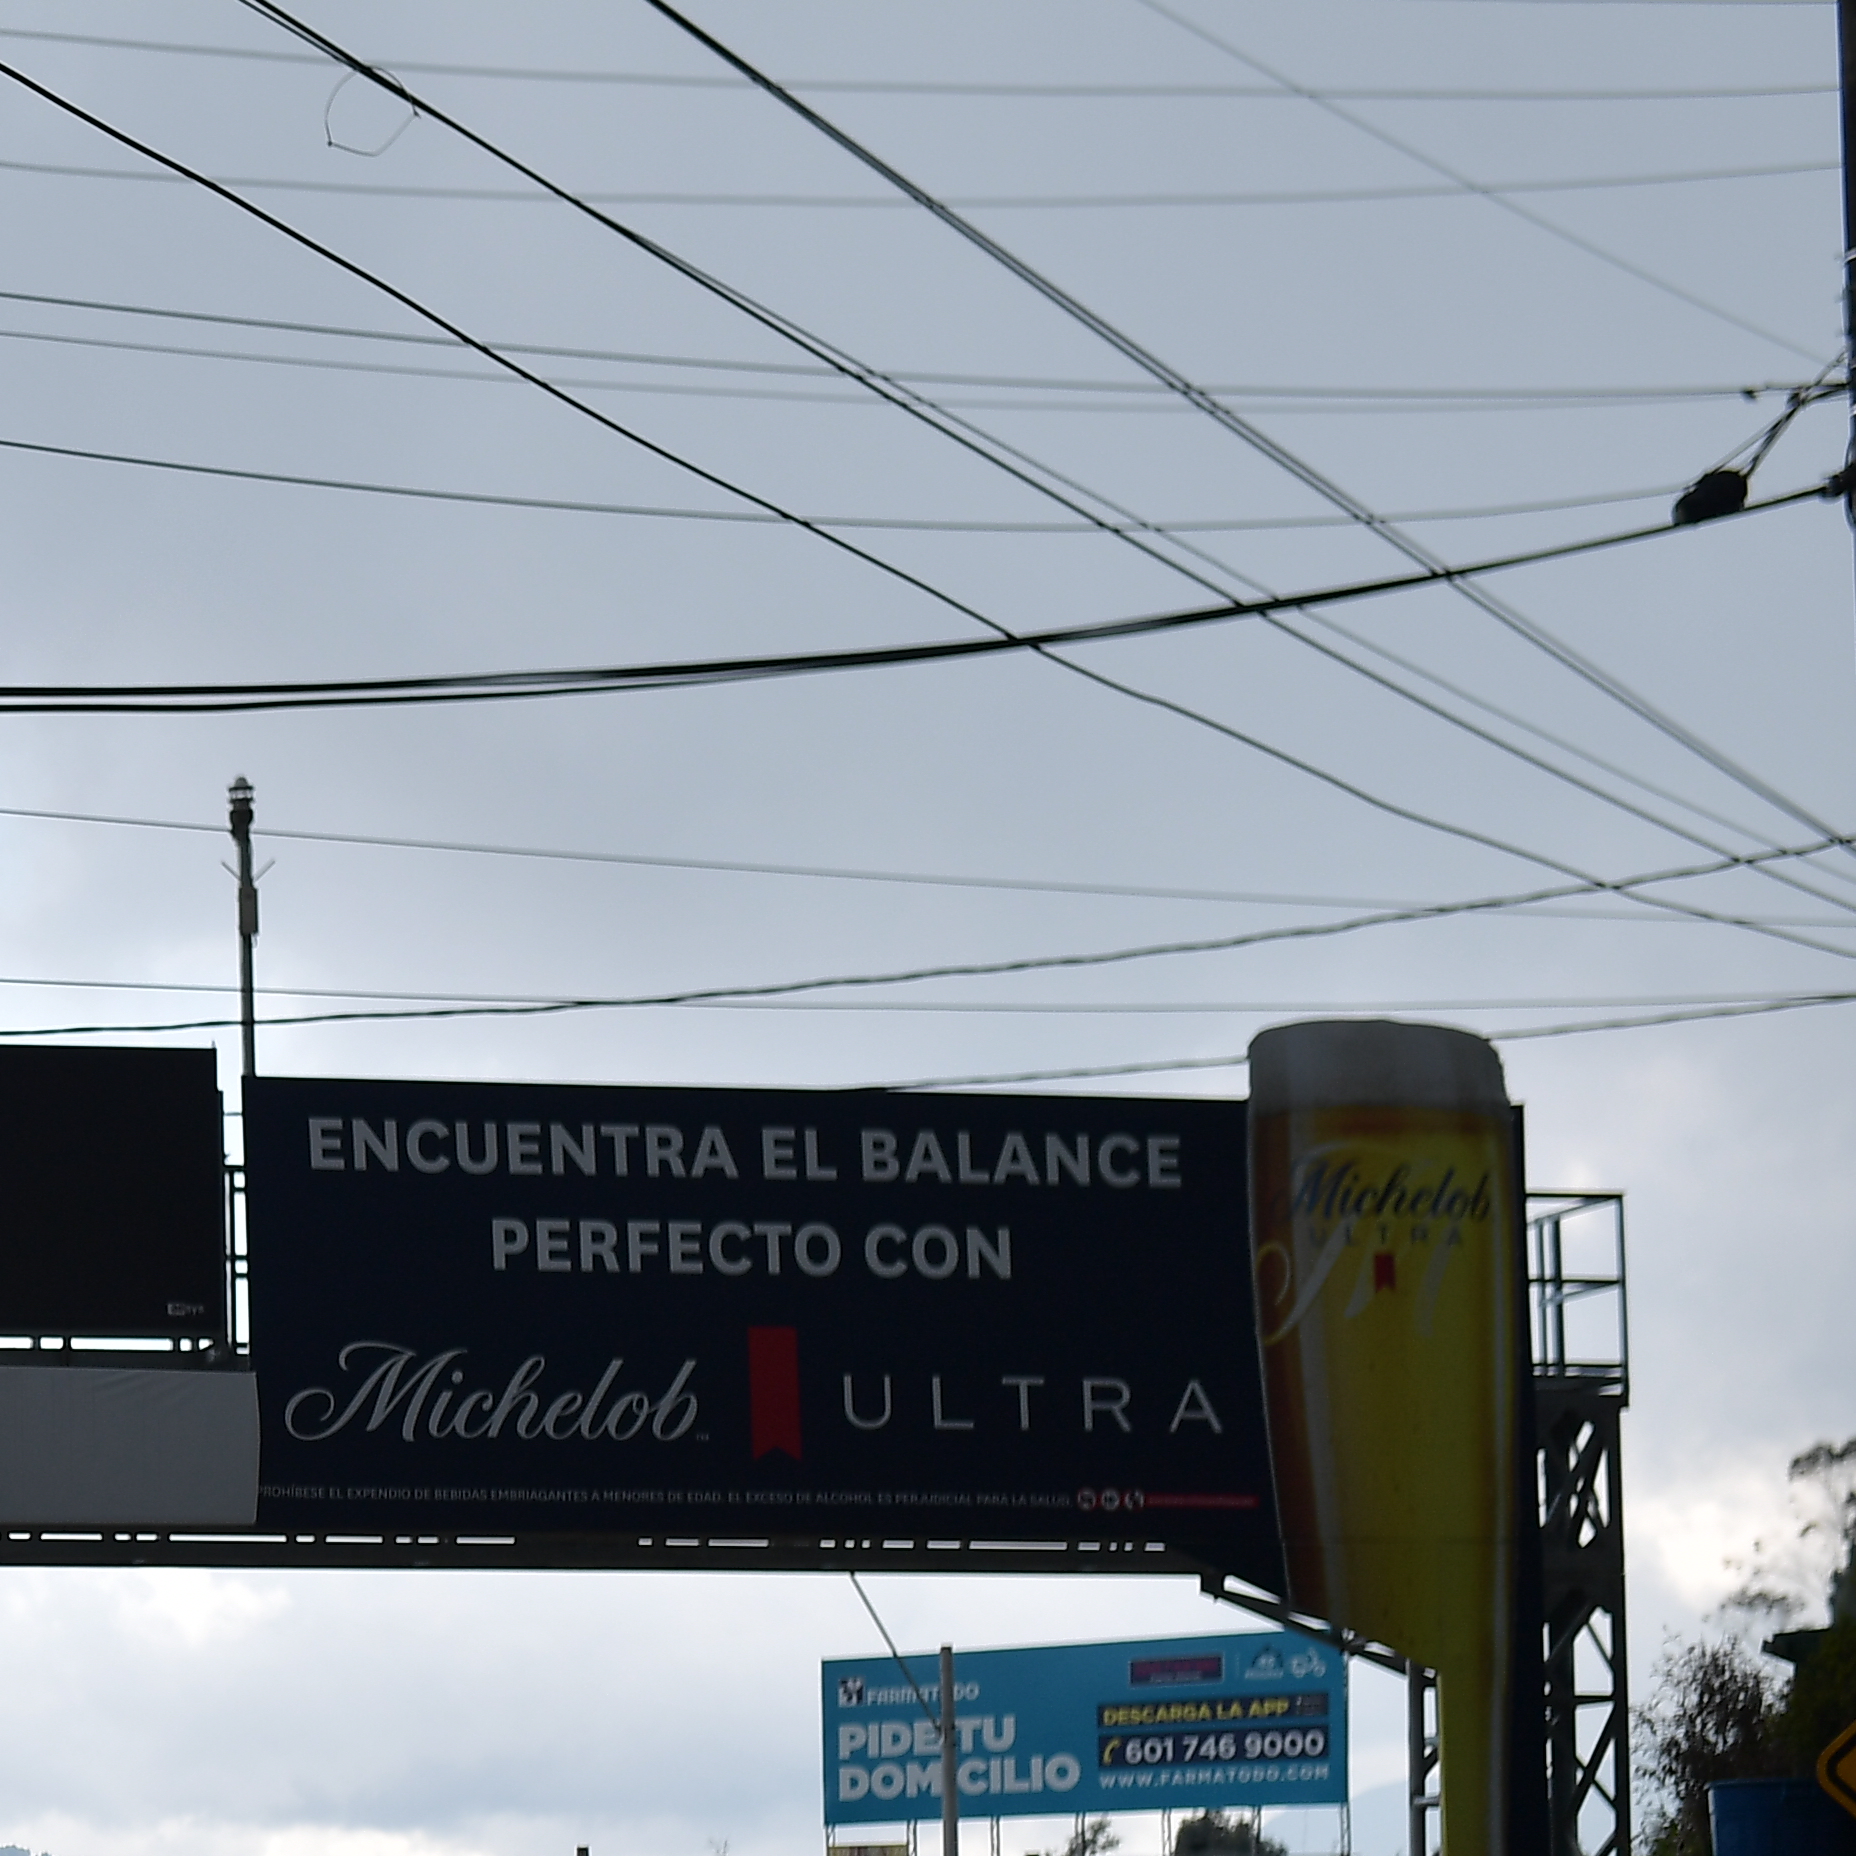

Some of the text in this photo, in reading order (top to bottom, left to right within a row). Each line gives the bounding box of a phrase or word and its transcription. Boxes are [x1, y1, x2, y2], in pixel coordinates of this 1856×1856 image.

[308, 1116, 1183, 1189] ENCUENTRA EL BALANCE
[491, 1218, 1013, 1280] PERFECTO CON
[284, 1340, 1224, 1445] Michelob ULTRA
[434, 1489, 487, 1501] BEBIDAS
[1102, 1702, 1213, 1726] DESCARGA
[1216, 1700, 1244, 1720] LA
[1248, 1697, 1290, 1717] APP
[838, 1713, 1017, 1760] PIDE TU
[1124, 1728, 1326, 1765] 601 746 9000
[838, 1752, 1082, 1802] DOMCILIO
[1100, 1763, 1330, 1789] WWW.FARMATODO.COM
